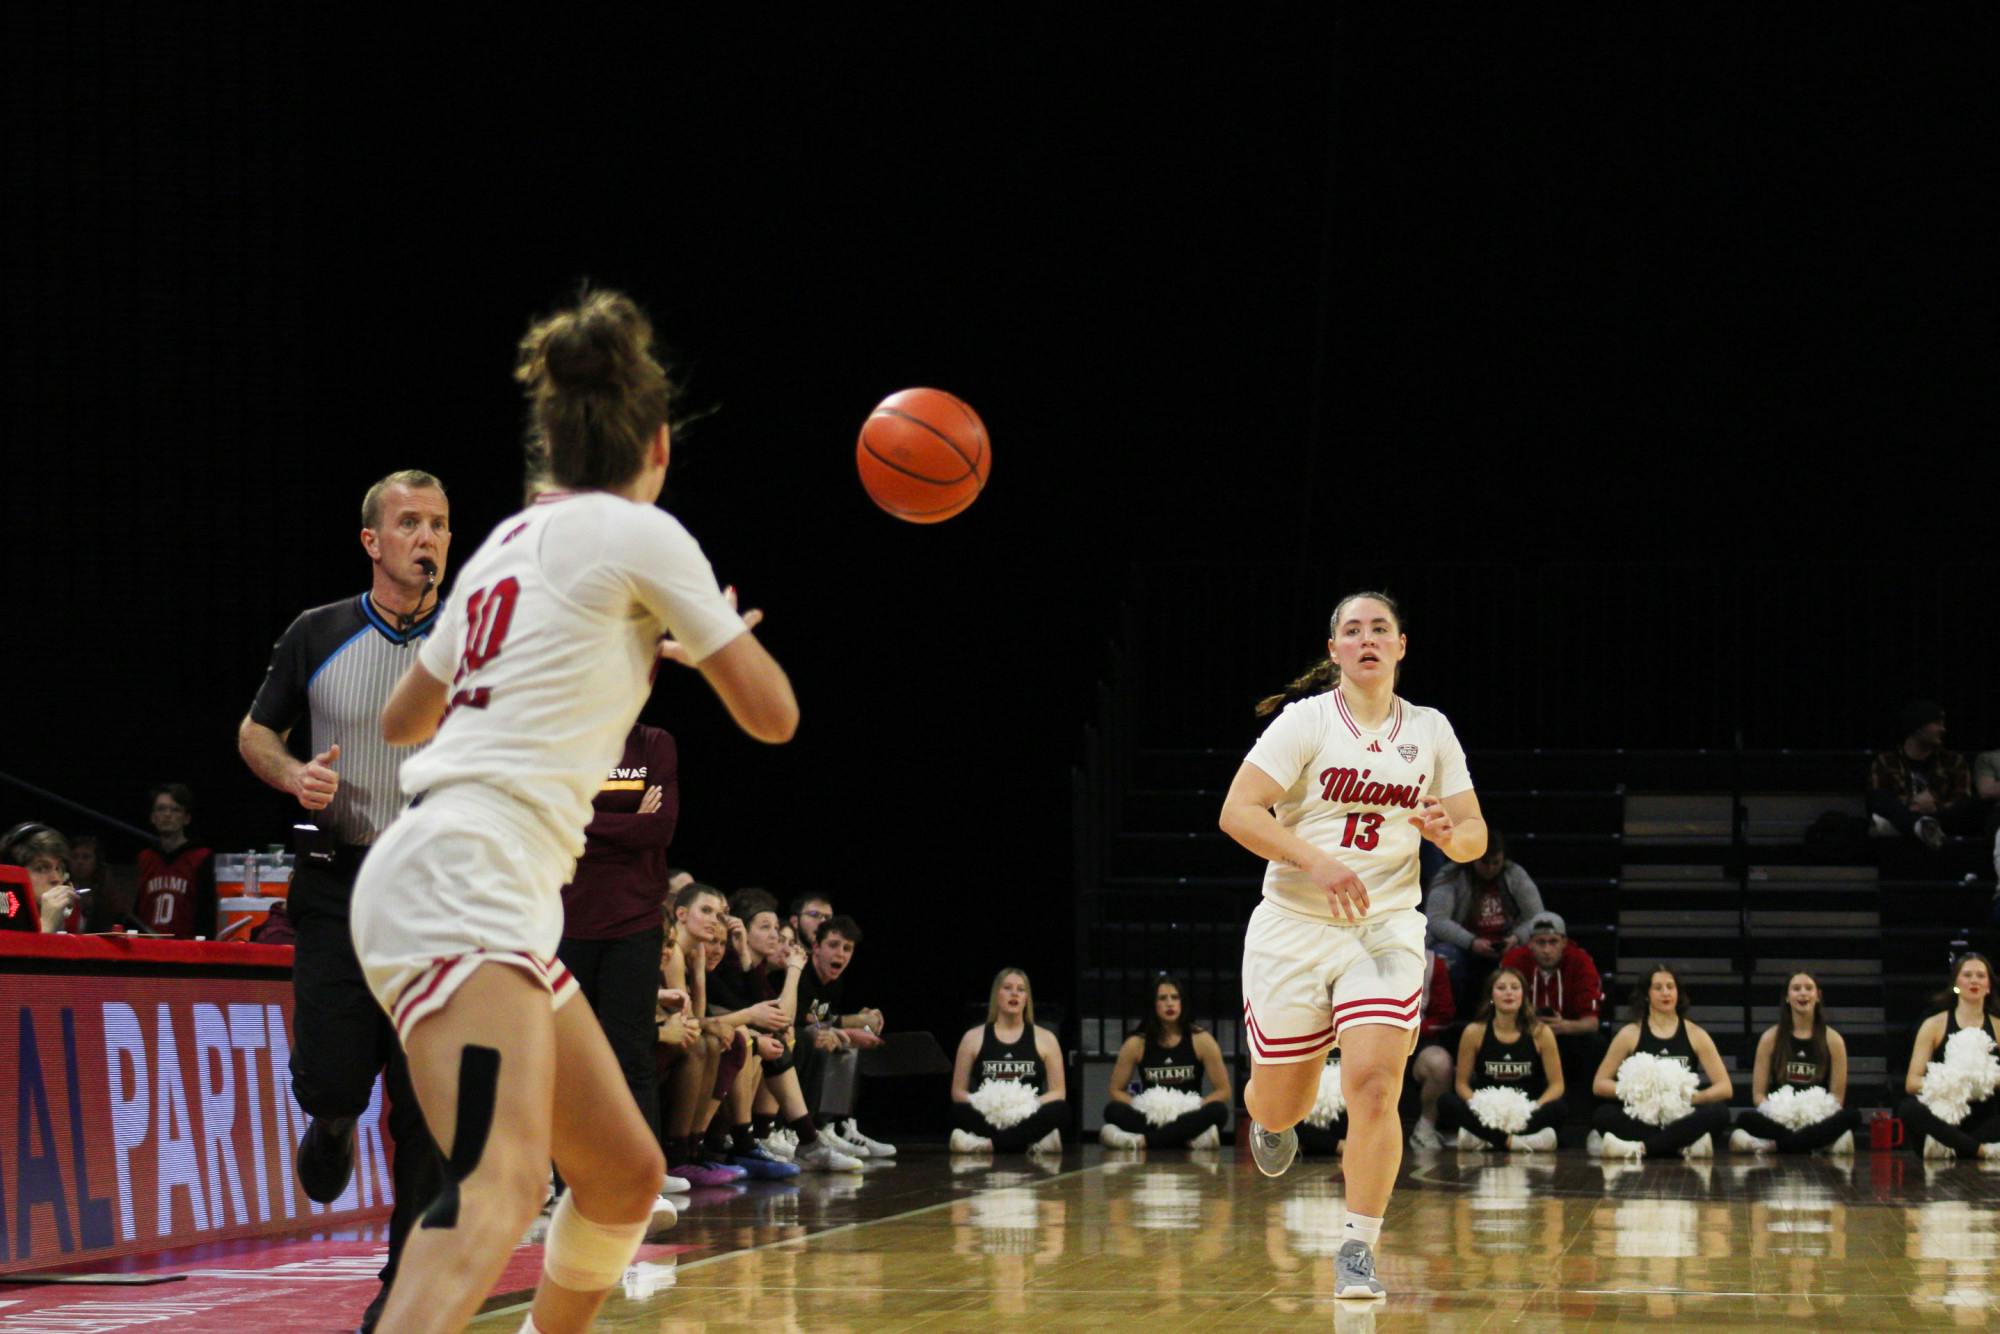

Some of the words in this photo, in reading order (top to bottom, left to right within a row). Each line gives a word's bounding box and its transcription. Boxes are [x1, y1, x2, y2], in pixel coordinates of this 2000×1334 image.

[453, 576, 521, 687] 10
[608, 767, 648, 779] EWAS
[1320, 766, 1426, 809] Miami
[1340, 812, 1385, 851] 13
[154, 893, 175, 924] 10
[987, 1063, 1031, 1073] MIAMI
[1146, 1068, 1192, 1080] MIAMI
[1488, 1063, 1528, 1073] MIAMI
[0, 1007, 115, 1261] AL
[102, 1001, 395, 1243] PARTNR
